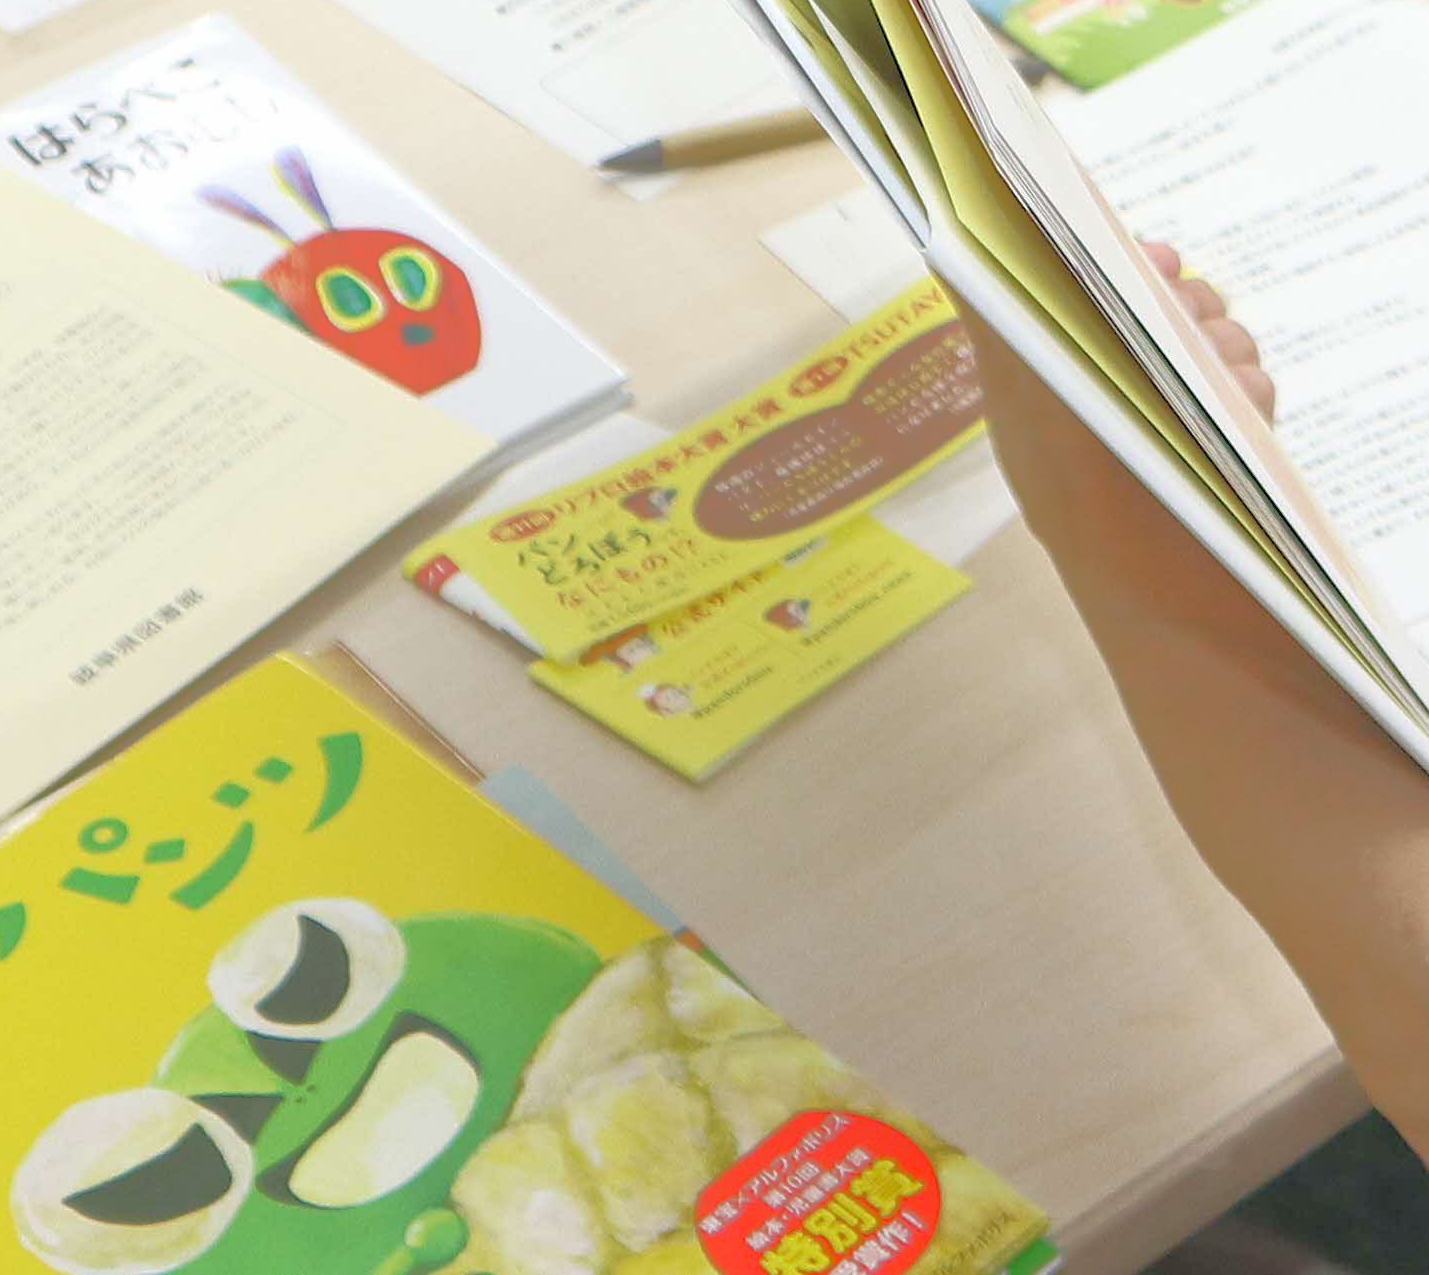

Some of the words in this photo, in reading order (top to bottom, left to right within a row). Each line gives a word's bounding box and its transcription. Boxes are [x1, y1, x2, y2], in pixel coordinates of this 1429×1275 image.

[759, 1160, 924, 1275] 特別賞
[763, 1161, 820, 1209] 第10回
